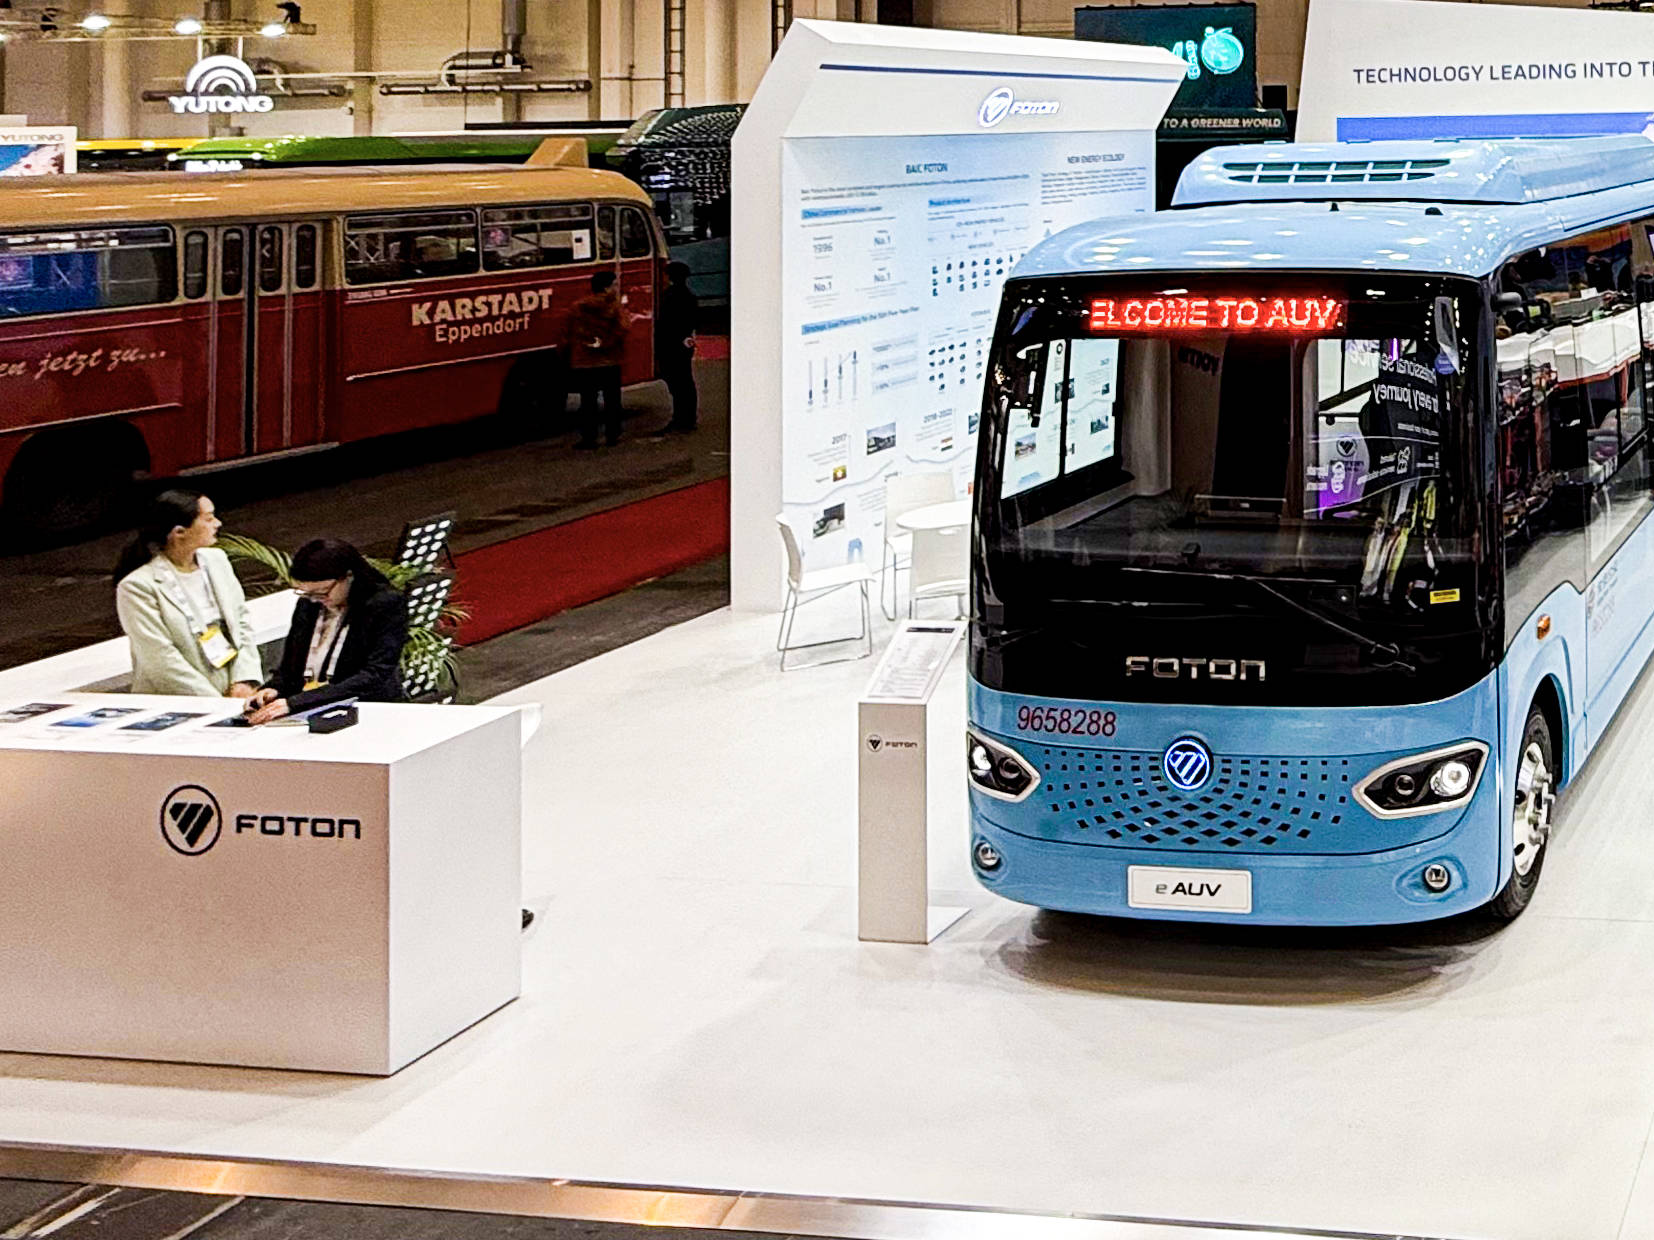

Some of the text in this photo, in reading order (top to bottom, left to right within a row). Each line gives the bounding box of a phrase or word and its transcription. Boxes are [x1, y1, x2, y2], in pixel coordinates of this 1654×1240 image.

[1353, 65, 1484, 84] TECHNOLOGY
[1489, 63, 1577, 81] LEADING
[1583, 61, 1632, 79] INTO
[169, 95, 273, 114] YUTONG
[1163, 118, 1281, 128] TO A GREENER WORLD
[1, 134, 64, 142] YUTONG
[411, 288, 553, 326] KARSTADT
[1092, 298, 1210, 327] ELCOME
[1215, 299, 1259, 327] TO
[435, 313, 531, 344] Eppendorf
[34, 348, 103, 380] jetzt
[1125, 656, 1266, 682] FOTON
[1017, 705, 1117, 738] 9658288
[236, 814, 361, 839] FOTON
[1155, 882, 1222, 898] e AUV
